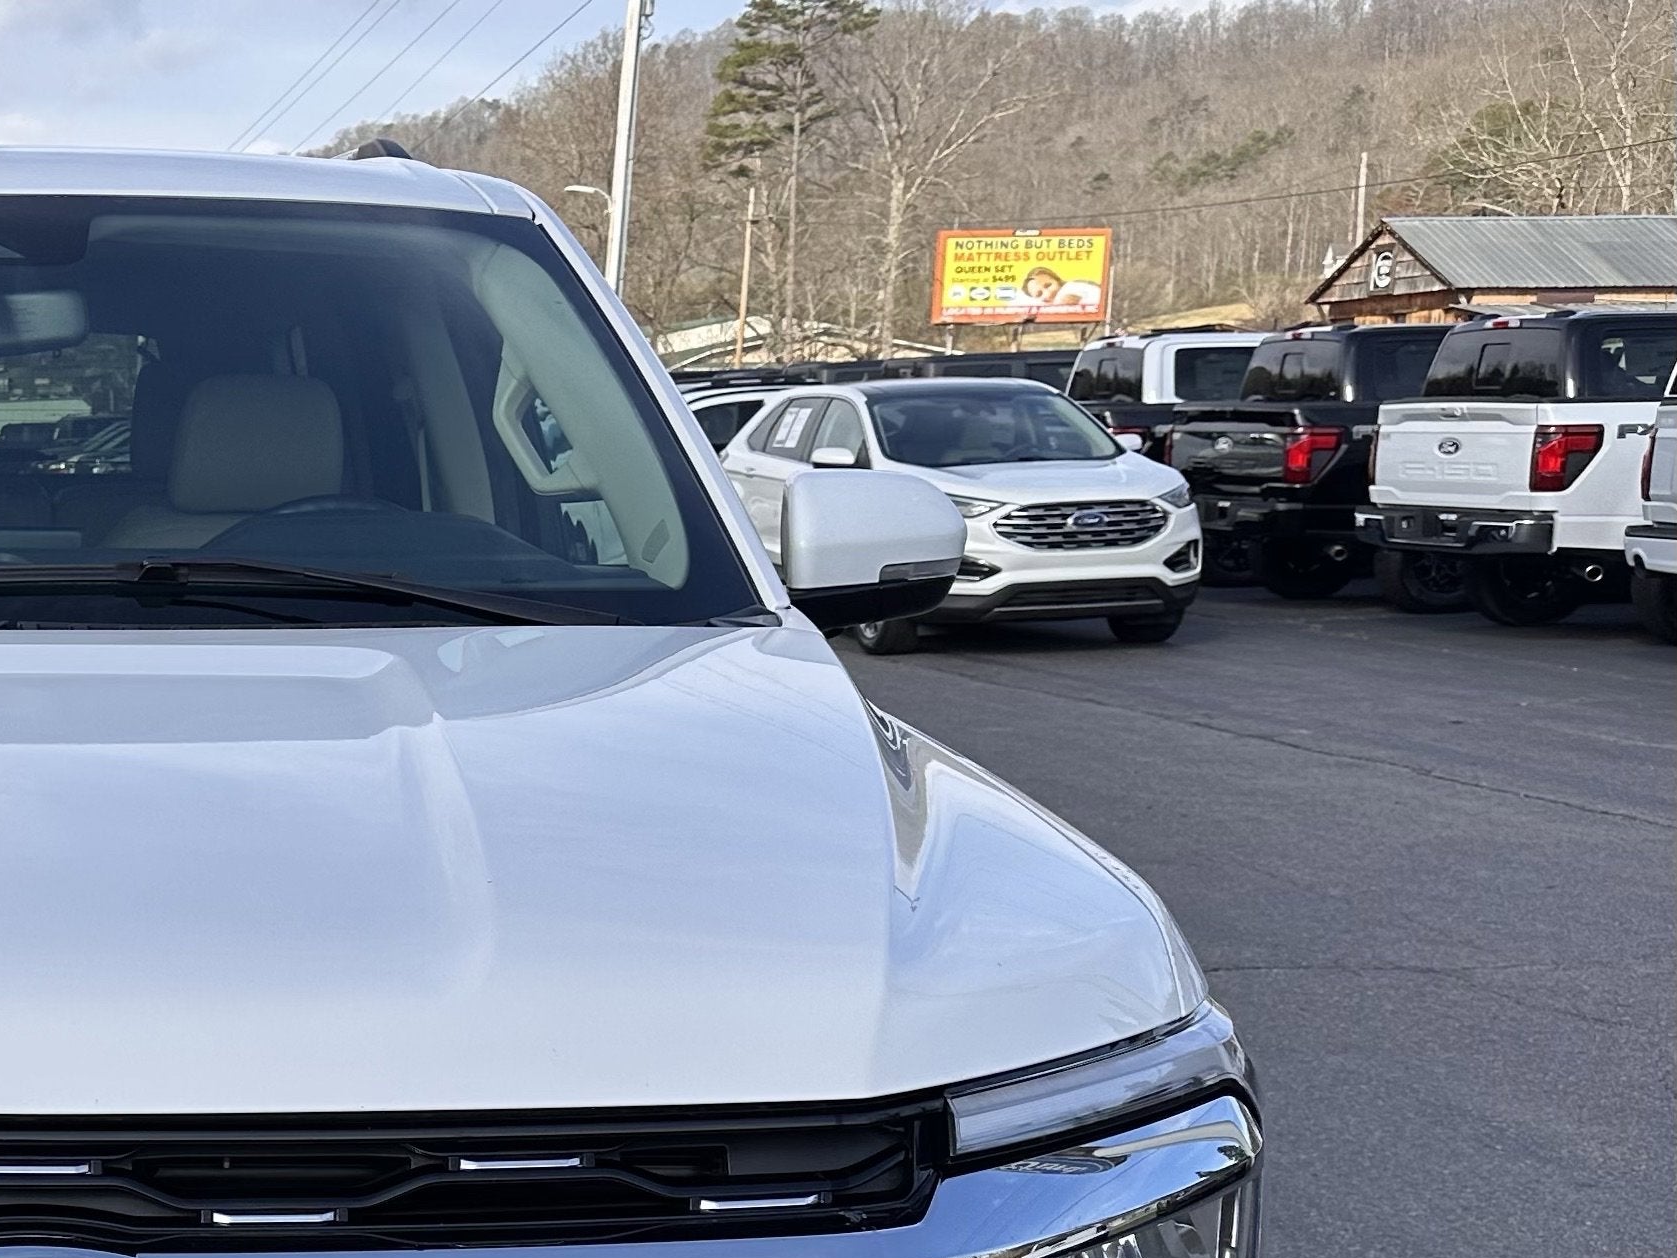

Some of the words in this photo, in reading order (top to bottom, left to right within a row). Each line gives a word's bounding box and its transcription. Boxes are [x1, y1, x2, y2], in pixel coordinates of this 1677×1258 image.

[954, 239, 1019, 250] NOTHING
[1024, 239, 1052, 249] BUT
[1057, 238, 1094, 249] BEDS
[954, 251, 1030, 262] MATTRESS
[1036, 250, 1092, 261] OUTLET
[954, 265, 992, 274] QUEEN
[994, 264, 1014, 273] SET
